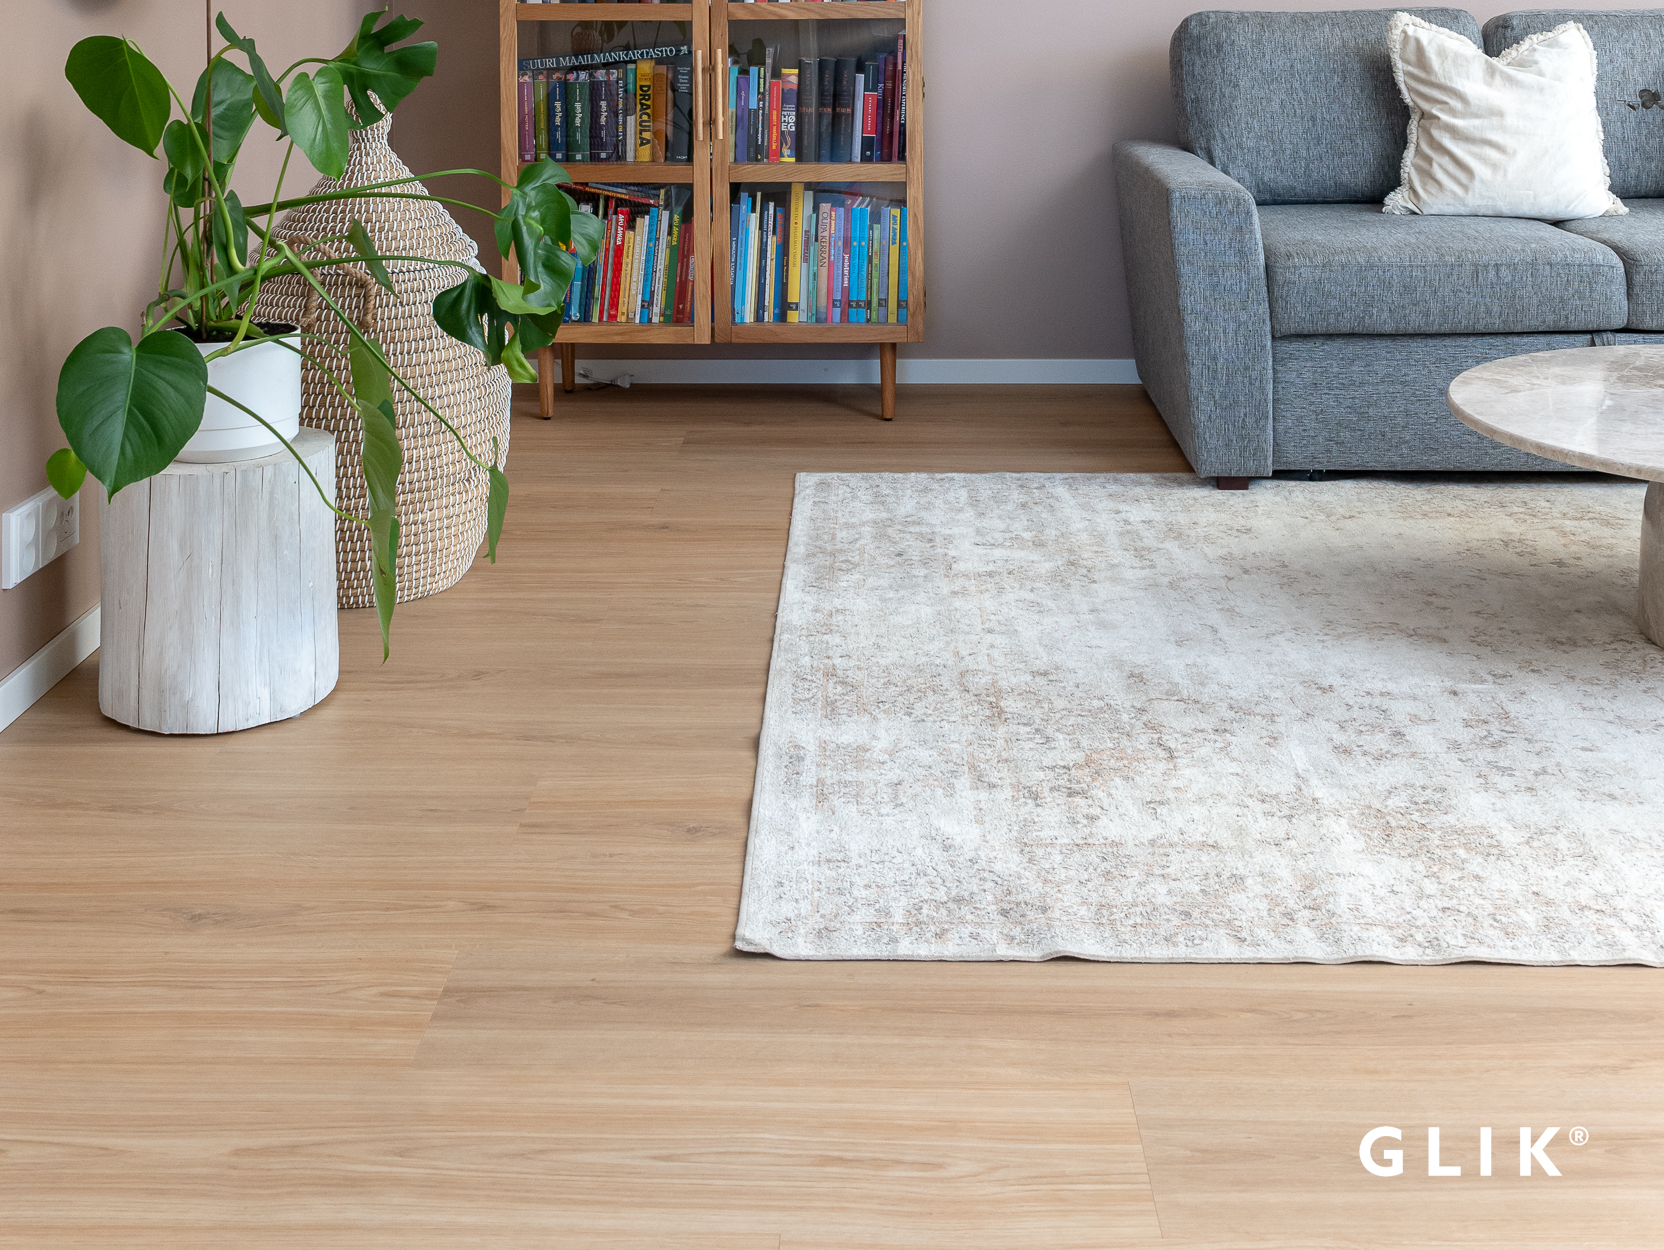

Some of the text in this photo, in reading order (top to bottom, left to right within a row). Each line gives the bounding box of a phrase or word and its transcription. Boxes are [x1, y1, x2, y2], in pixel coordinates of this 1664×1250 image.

[522, 46, 676, 70] SUURI MAAILMANKARTASTO
[638, 84, 652, 148] DRACULA
[819, 235, 828, 268] KERRAN
